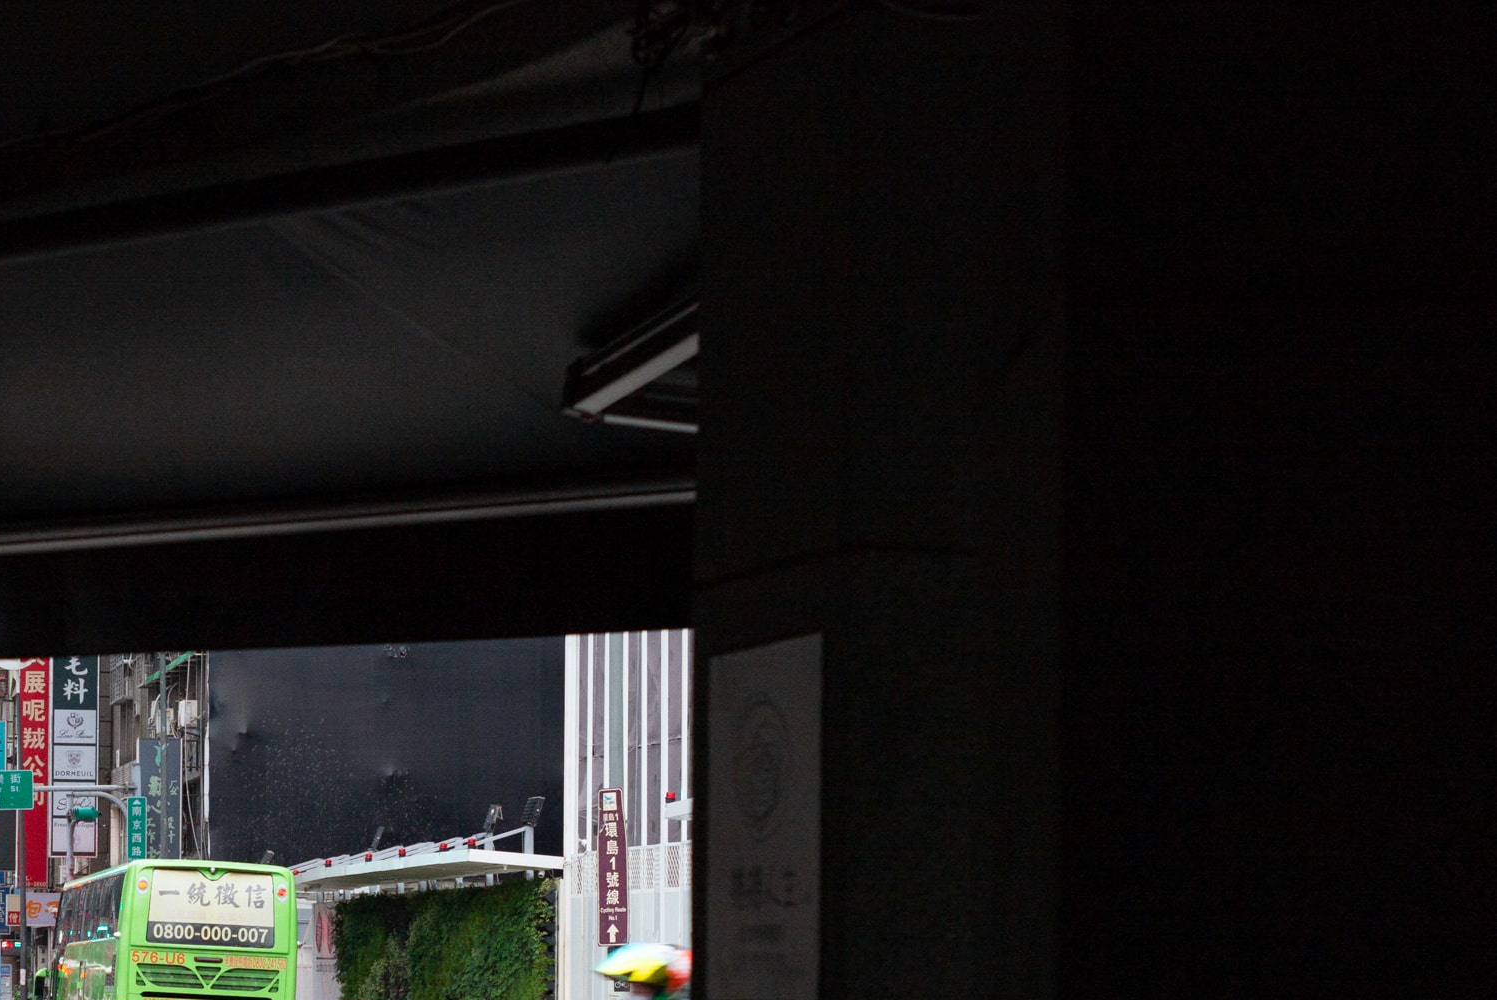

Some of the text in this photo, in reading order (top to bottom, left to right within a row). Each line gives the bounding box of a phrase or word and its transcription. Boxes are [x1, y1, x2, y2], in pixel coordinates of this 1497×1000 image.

[63, 656, 89, 705] 毛料
[54, 770, 94, 778] DORMEUIL
[131, 806, 142, 857] 南京西路
[604, 823, 620, 905] 環島1號線
[159, 882, 267, 909] 一統徵信
[153, 923, 269, 944] 0800-000-007
[131, 950, 186, 965] 576-U6
